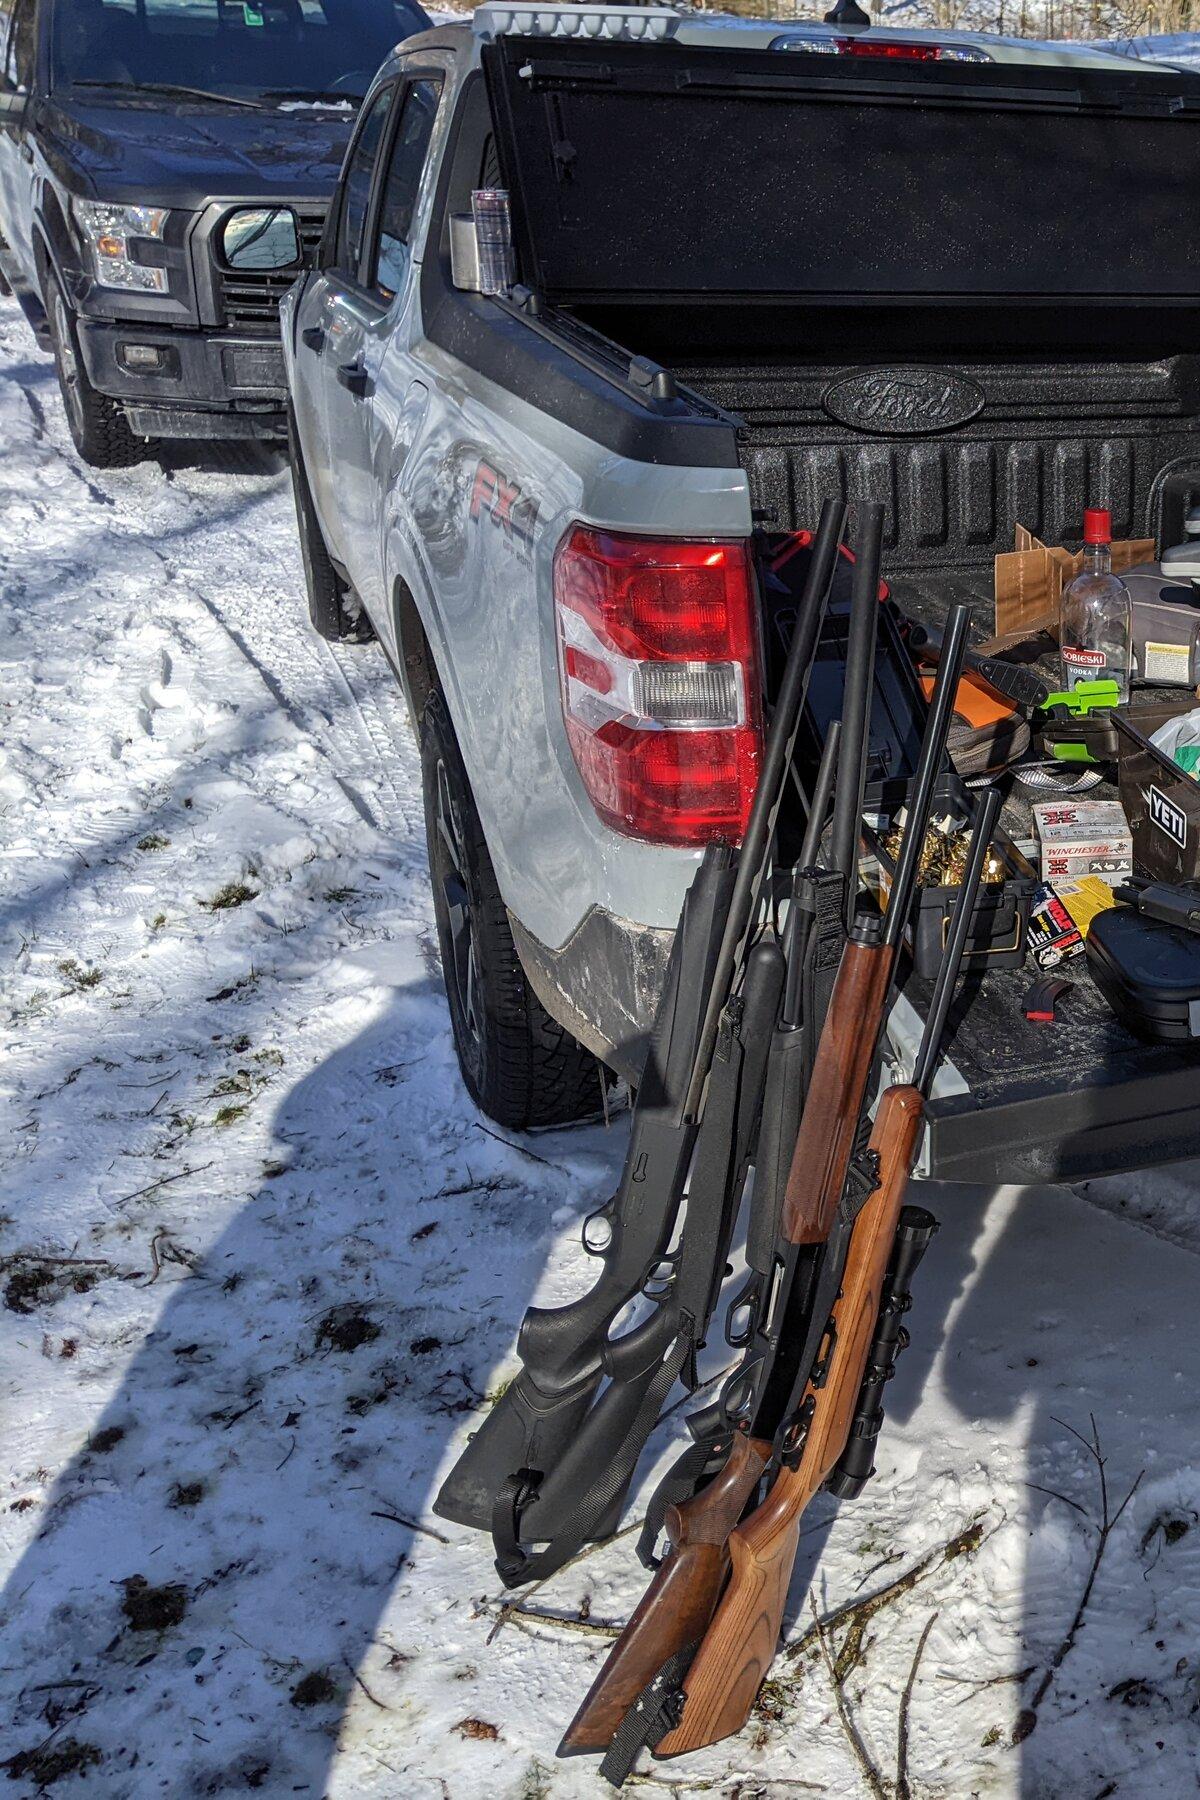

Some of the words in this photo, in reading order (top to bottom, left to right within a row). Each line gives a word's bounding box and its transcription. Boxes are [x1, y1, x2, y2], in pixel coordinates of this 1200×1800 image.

[854, 379, 951, 420] Ford
[469, 456, 541, 547] FX4
[1062, 650, 1103, 664] SOBIESKI
[1069, 667, 1092, 676] VODKA
[1152, 793, 1184, 839] YETI
[1046, 845, 1109, 856] WINCHESTER
[1048, 898, 1075, 932] WOLF
